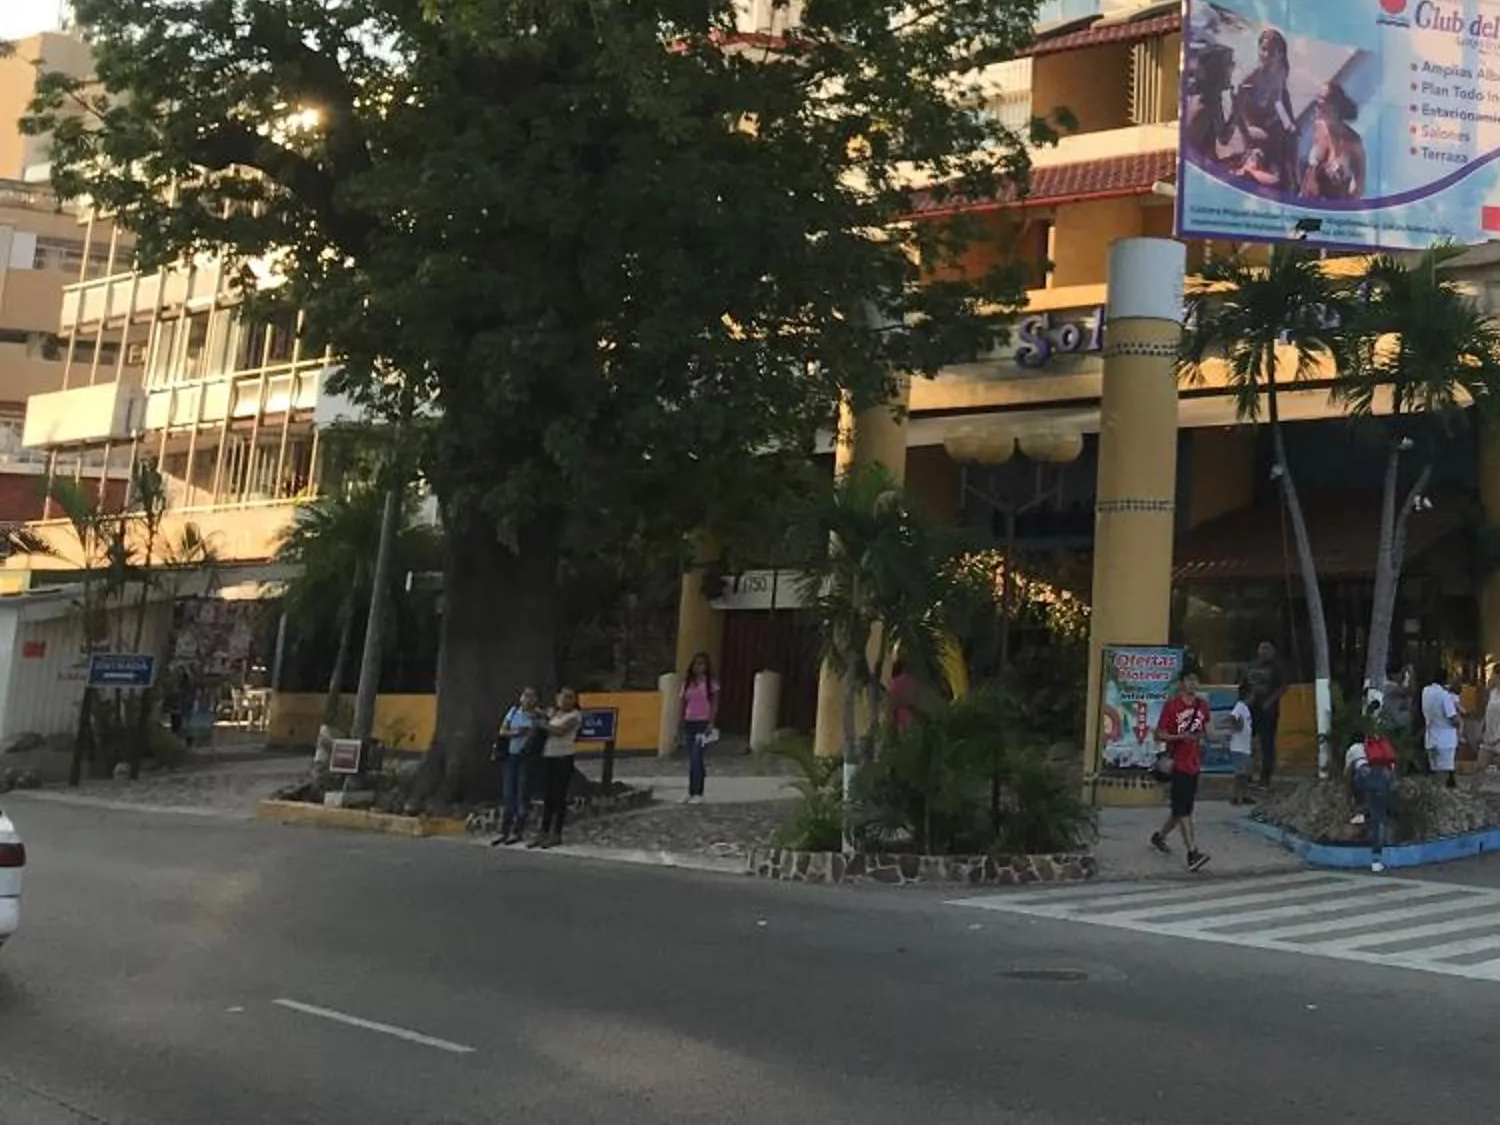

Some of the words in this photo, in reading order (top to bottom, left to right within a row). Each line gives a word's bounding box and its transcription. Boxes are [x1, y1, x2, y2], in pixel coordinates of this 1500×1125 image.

[1415, 0, 1464, 33] Club
[1469, 15, 1500, 38] del
[1421, 81, 1449, 96] Plan
[1453, 85, 1485, 101] Todo
[1421, 124, 1471, 142] Salones
[1421, 146, 1469, 164] Terraza
[1114, 653, 1176, 668] Ofertas
